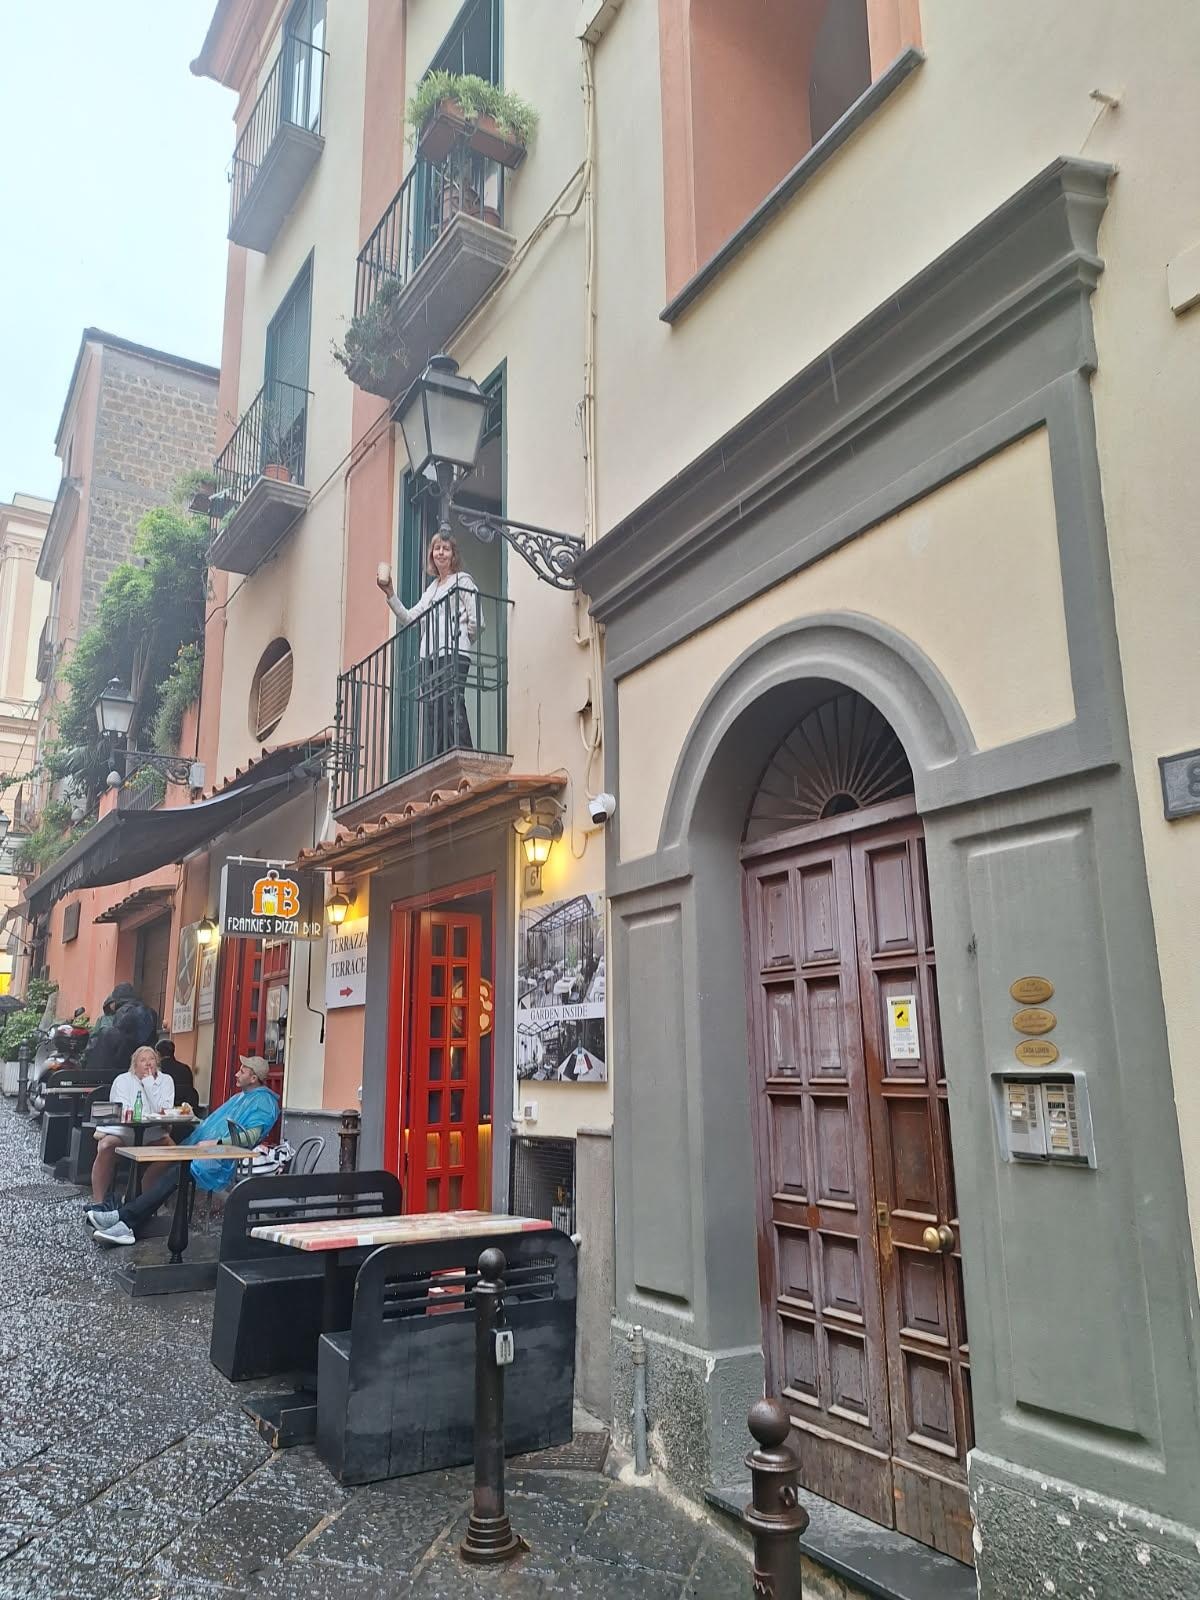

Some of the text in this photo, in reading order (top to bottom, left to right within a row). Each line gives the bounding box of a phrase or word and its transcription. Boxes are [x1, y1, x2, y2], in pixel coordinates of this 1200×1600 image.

[530, 870, 536, 887] 6
[227, 917, 272, 933] FRANKIE'S
[275, 920, 299, 934] PIZZA
[331, 957, 367, 978] TERRACE
[530, 1005, 588, 1020] GARDEN INSIDE
